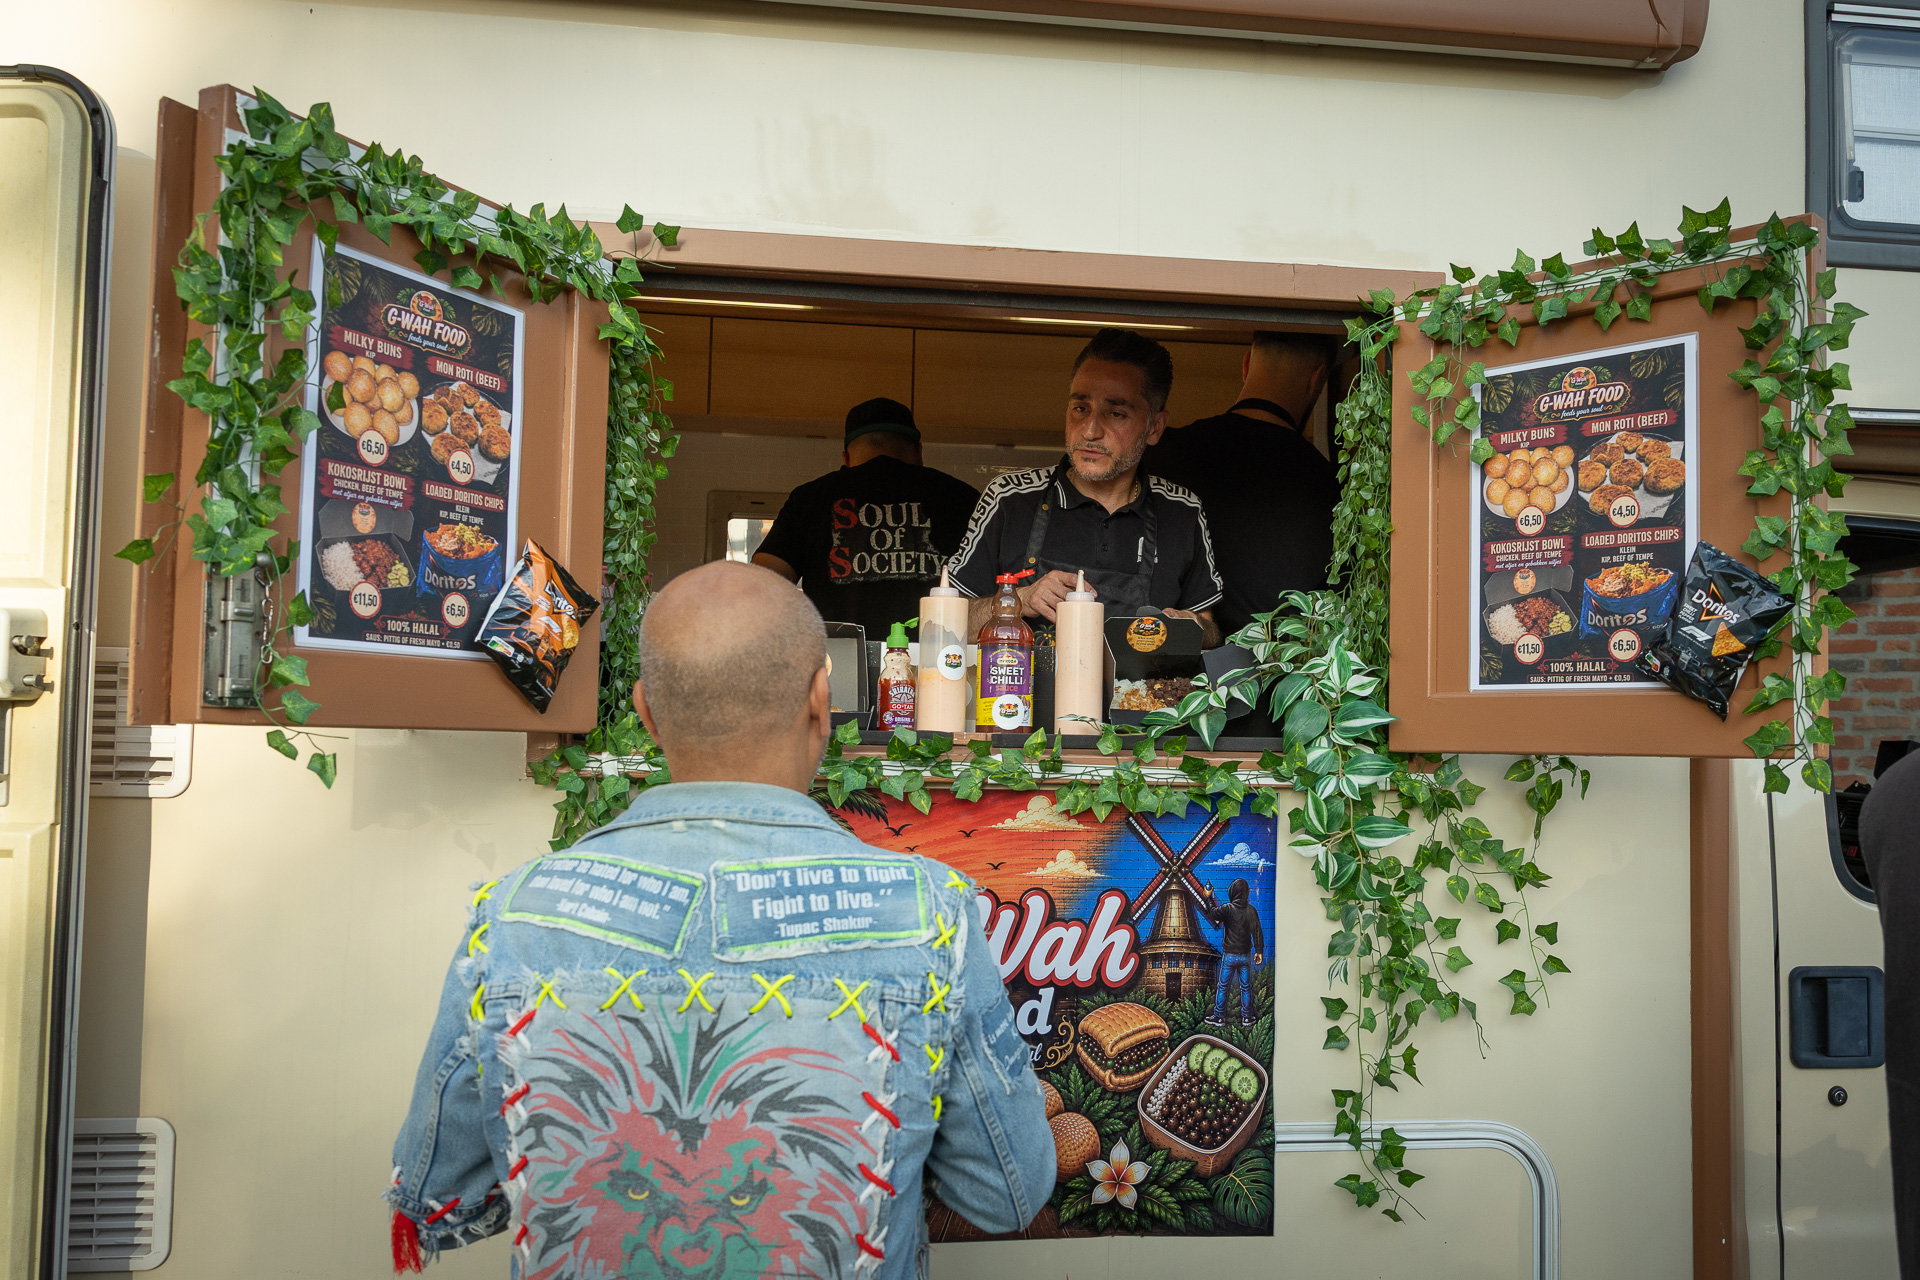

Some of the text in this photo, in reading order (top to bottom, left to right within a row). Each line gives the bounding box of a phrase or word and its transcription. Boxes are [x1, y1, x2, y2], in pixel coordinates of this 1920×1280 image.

[387, 307, 467, 347] G-WAH FOOD
[343, 330, 402, 359] MILKY BUNS
[408, 333, 448, 351] feeds your soul
[365, 350, 376, 359] KIP
[436, 359, 501, 391] MON ROTI (BEEF)
[1540, 385, 1624, 413] G-WAH FOOD
[1560, 404, 1604, 419] feeds your soul
[1591, 412, 1668, 434] MON ROTI (BEEF)
[1500, 427, 1555, 445] MILKY BUNS
[361, 439, 385, 457] €6,50
[1520, 441, 1530, 449] KIP
[451, 459, 471, 476] €4,50
[328, 462, 407, 491] KOKOSRIJST BOWL
[997, 469, 1043, 489] JUST
[361, 484, 376, 494] BEEF
[376, 486, 385, 496] OF
[385, 488, 403, 499] TEMPE
[425, 483, 504, 511] LOADED DORITOS CHIPS
[455, 504, 470, 514] KLEIN
[833, 498, 931, 529] SOUL
[1612, 505, 1636, 519] €4,50
[449, 512, 461, 521] BEEF
[461, 514, 469, 522] OF
[468, 516, 484, 525] TEMPE
[1519, 514, 1542, 528] €6,50
[1585, 528, 1680, 547] LOADED DORITOS CHIPS
[1490, 538, 1566, 554] KOKOSRIJST BOWL
[1619, 546, 1636, 554] KLEIN
[1521, 552, 1535, 560] BEEF
[1535, 551, 1543, 559] OF
[1543, 550, 1562, 558] TEMPE
[1612, 554, 1626, 563] BEEF
[1626, 553, 1635, 561] OF
[1635, 553, 1654, 561] TEMPE
[424, 566, 477, 590] Doritos
[353, 592, 378, 607] €11,50
[1691, 588, 1740, 624] Doritos
[446, 603, 466, 617] €6,50
[1587, 608, 1648, 628] Doritos
[387, 619, 440, 636] 100% HALAL
[365, 633, 383, 643] SAUS:
[383, 634, 401, 643] PITTIG
[401, 636, 410, 644] OF
[409, 637, 426, 646] FRESH
[426, 638, 441, 647] MAYO
[1613, 639, 1636, 652] €6,50
[1517, 643, 1541, 655] €11,50
[990, 667, 1025, 676] SWEET
[1550, 660, 1606, 673] 100% HALAL
[990, 676, 1023, 685] CHILLI
[1547, 675, 1565, 683] PITTIG
[1565, 675, 1573, 683] OF
[1573, 675, 1592, 683] FRESH
[1592, 674, 1608, 682] MAYO
[796, 867, 834, 886] live
[840, 866, 860, 883] to
[863, 866, 915, 883] fight.
[752, 888, 893, 919] Fight to live."
[774, 916, 878, 938] -Tupac Shakur-
